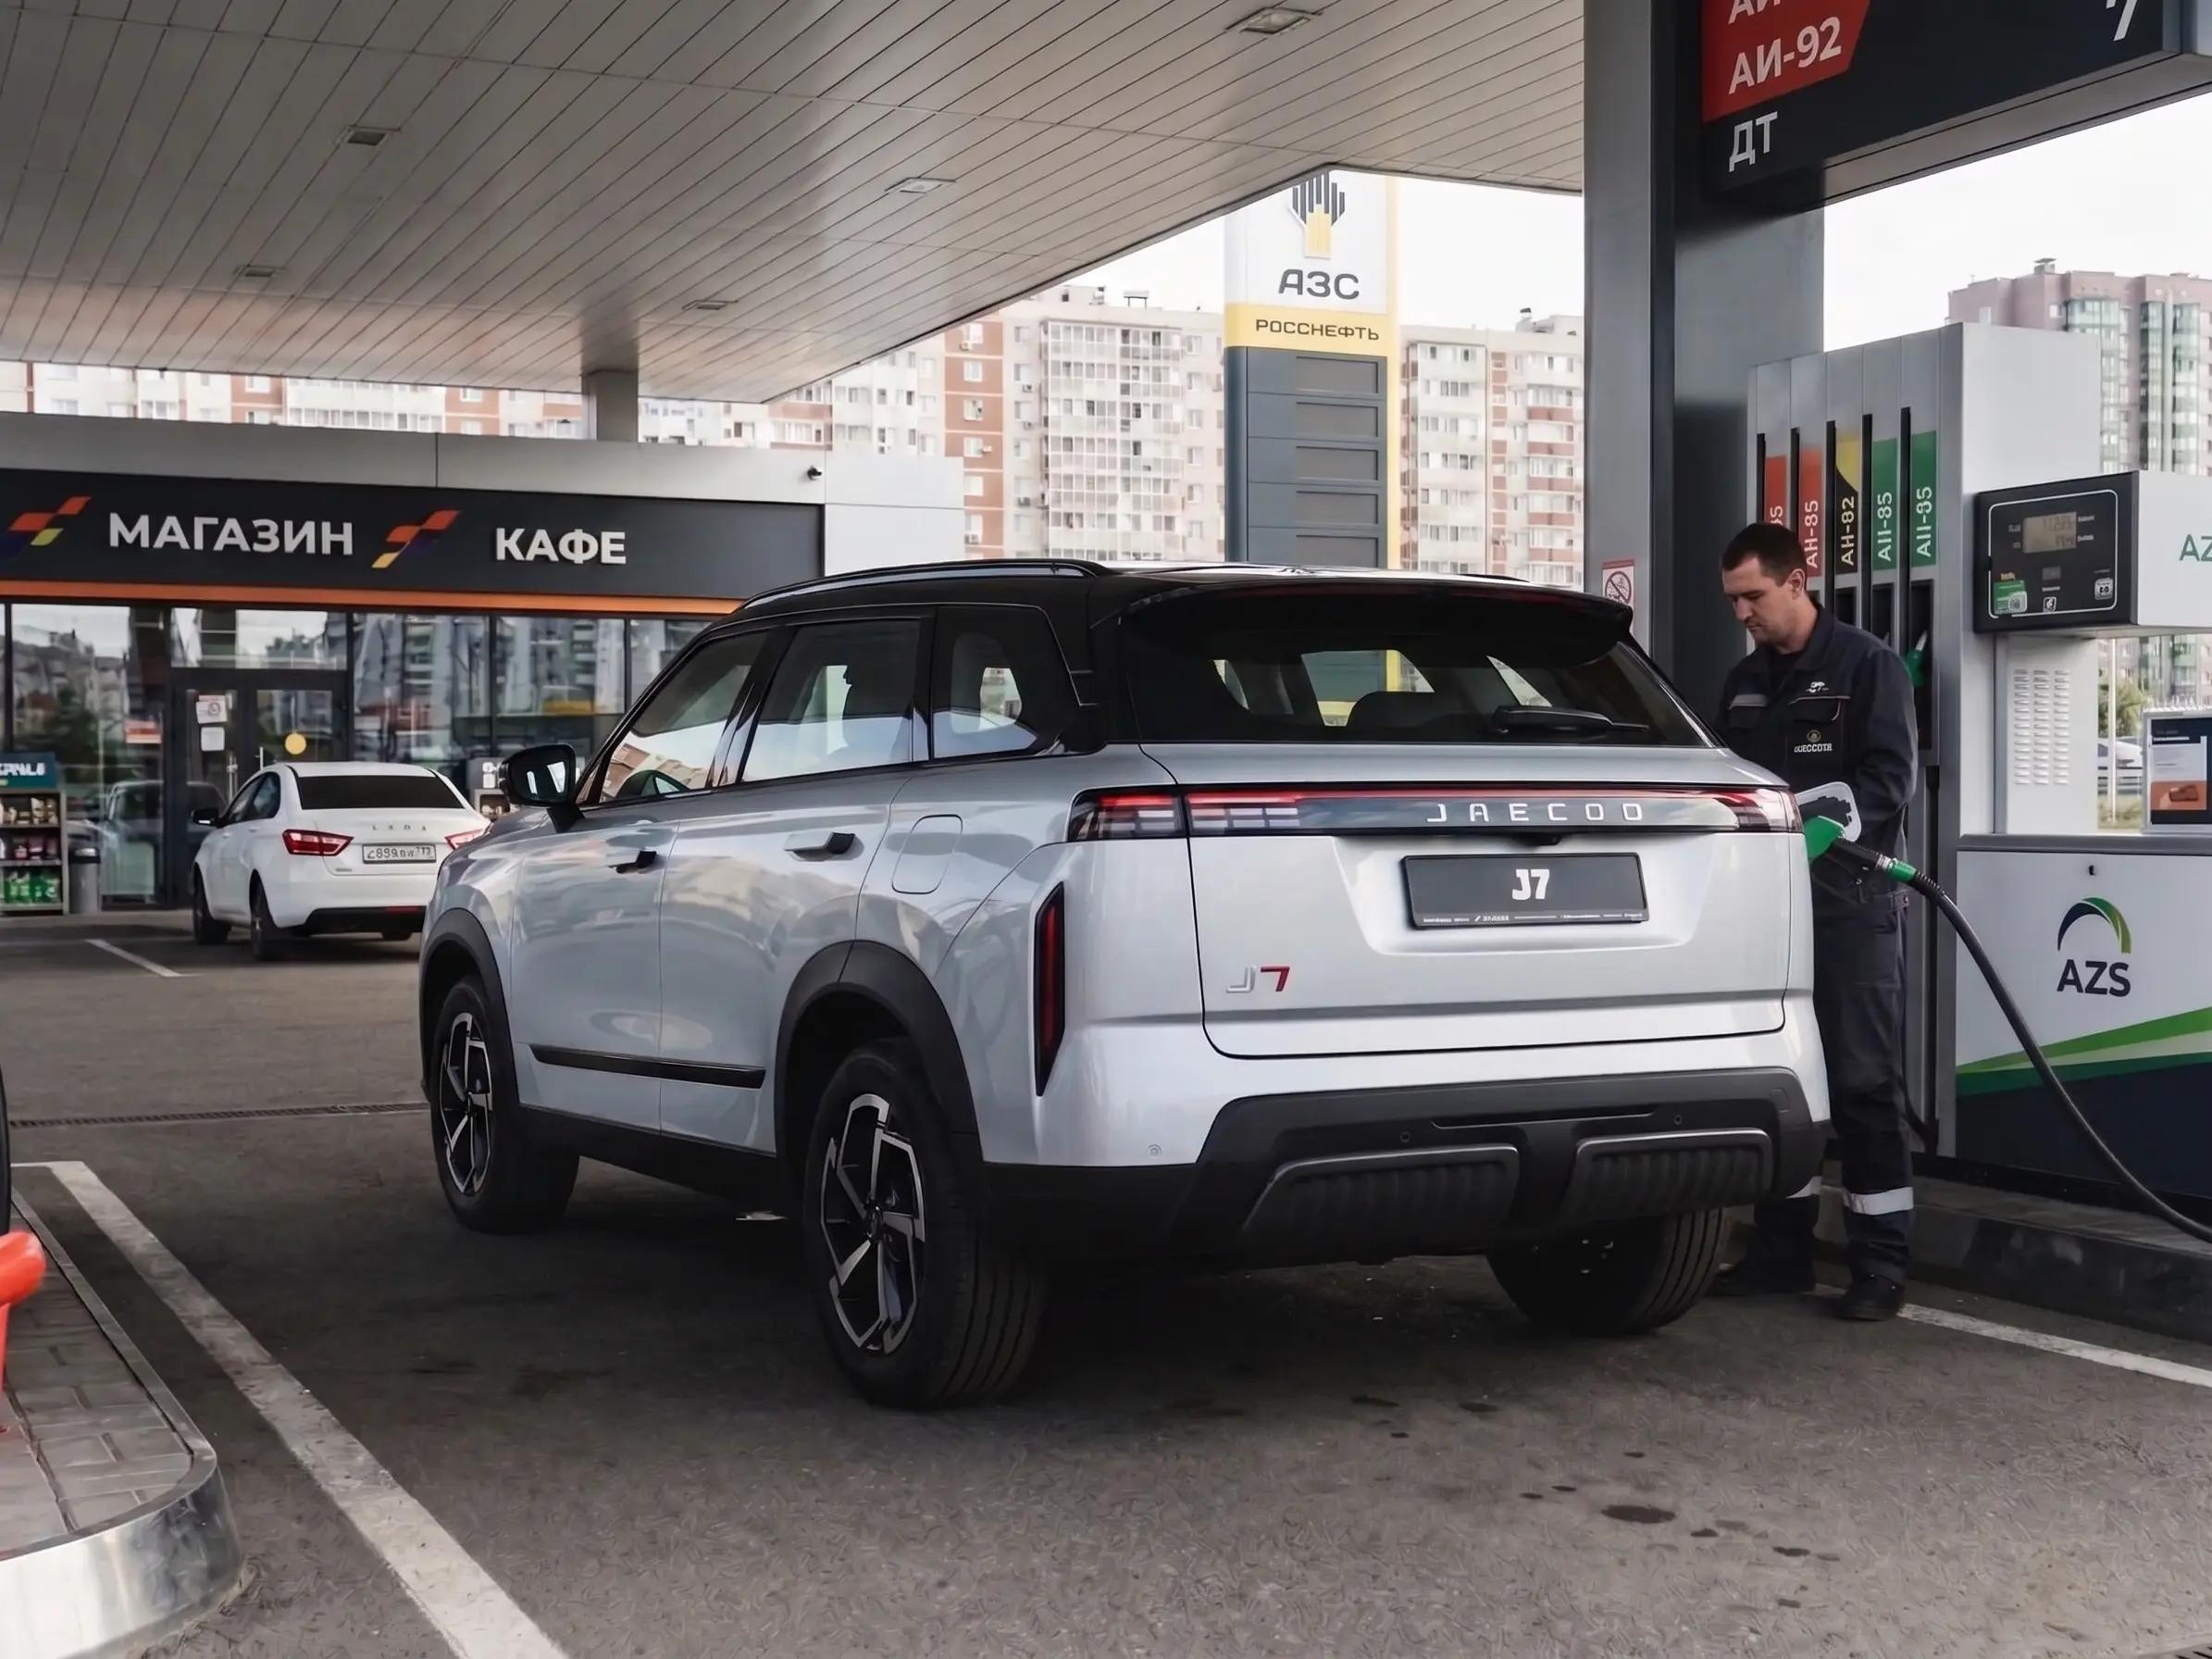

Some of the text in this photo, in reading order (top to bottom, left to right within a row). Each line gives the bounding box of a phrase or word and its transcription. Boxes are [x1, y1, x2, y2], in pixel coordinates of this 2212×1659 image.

[1728, 16, 1842, 95] АИ-92
[1728, 111, 1778, 173] ДТ
[1278, 268, 1360, 300] АЗС
[1255, 318, 1379, 341] РОССНЕФТЬ
[108, 512, 354, 555] МАГАЗИН
[495, 527, 627, 565] КАФЕ
[1426, 803, 1644, 822] JAECOO
[1511, 868, 1550, 901] J7
[1225, 965, 1290, 993] J7
[2057, 958, 2131, 998] AZS
